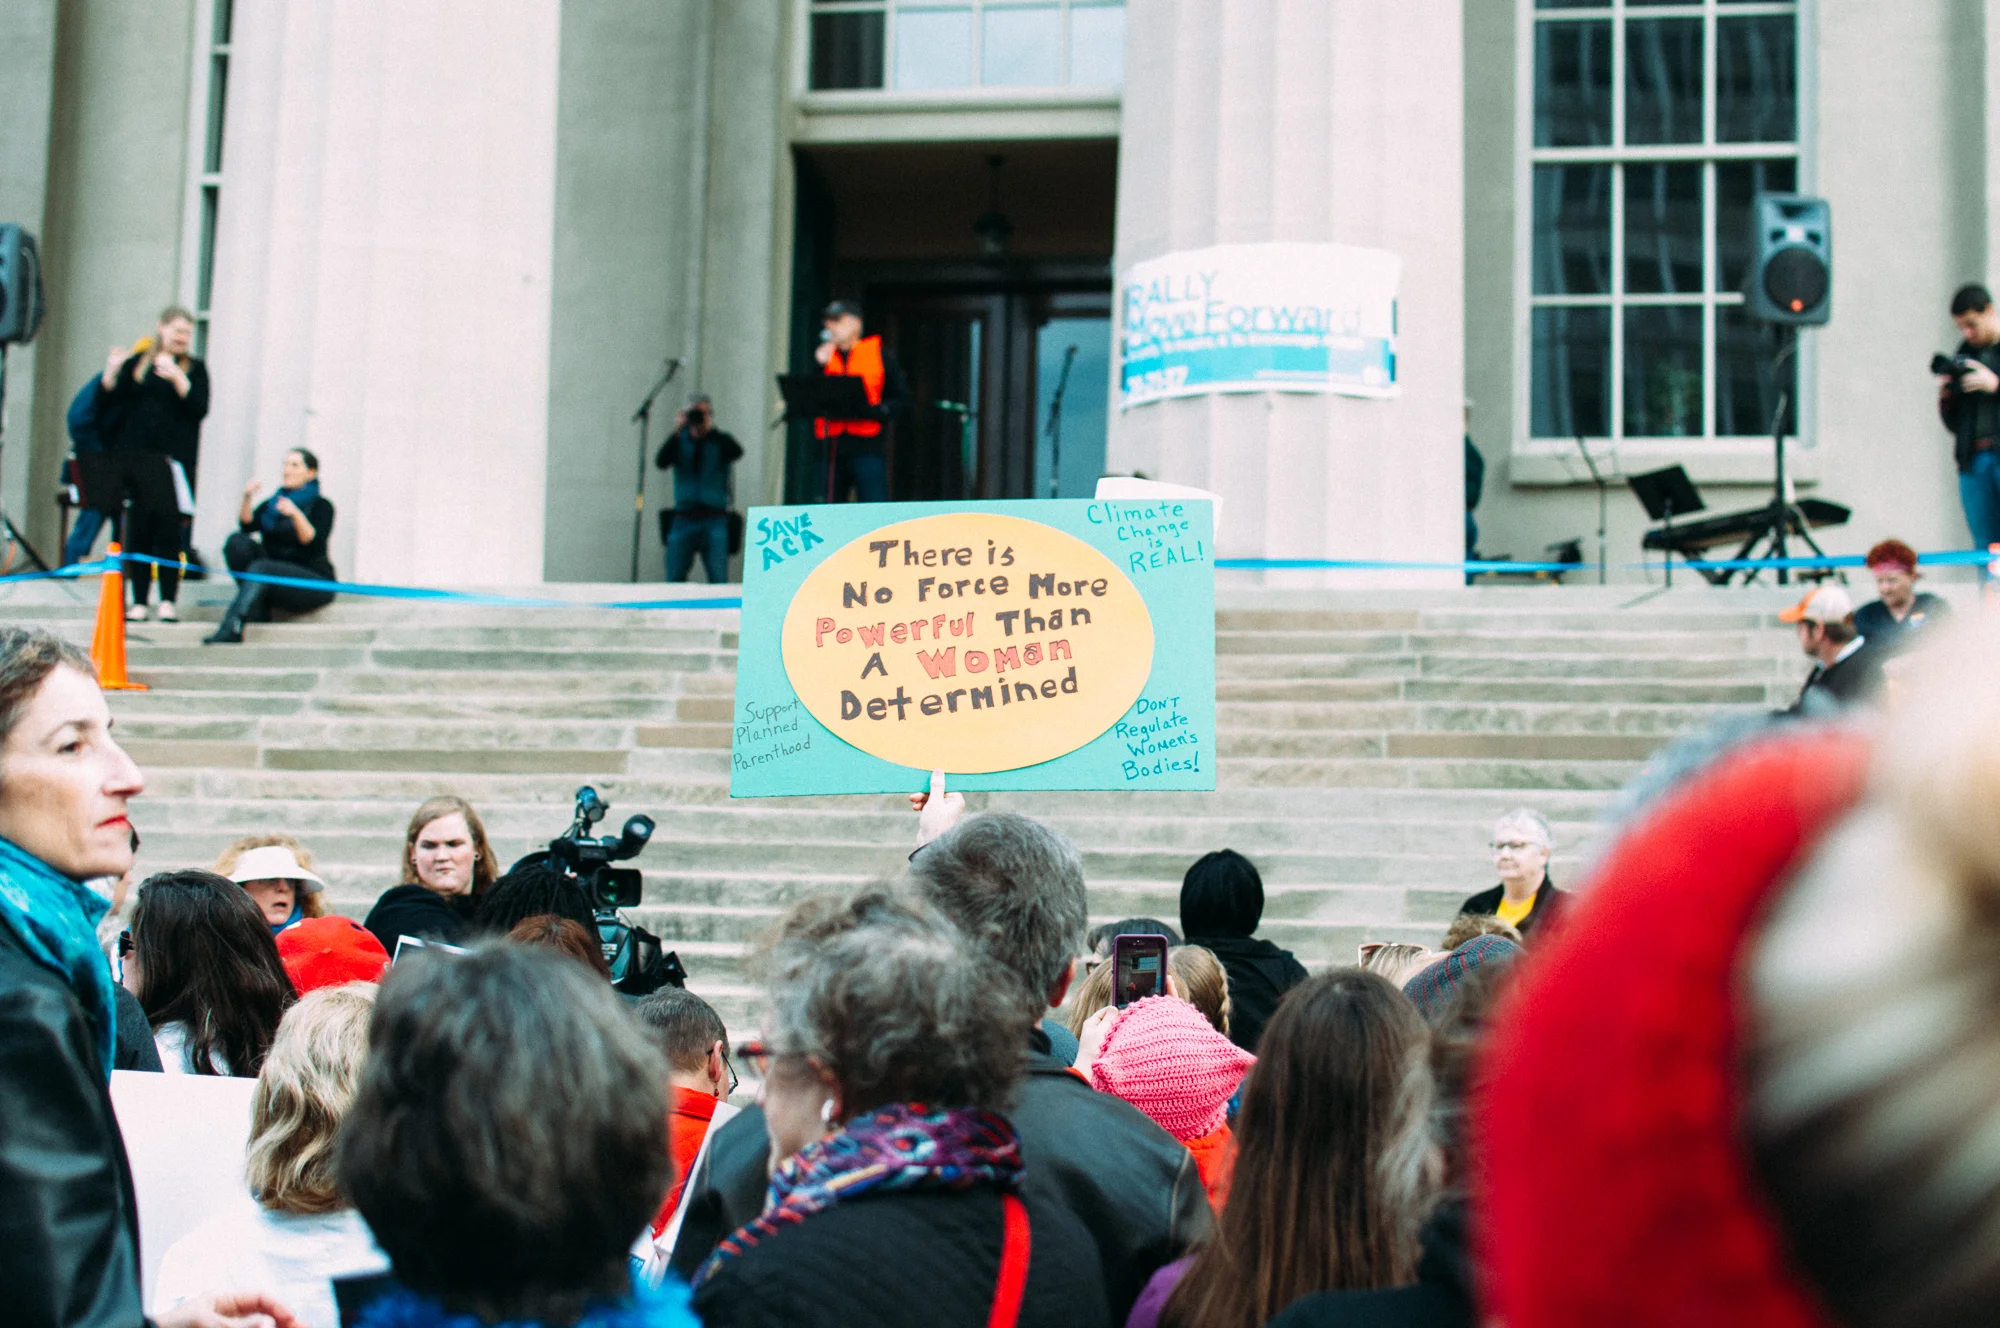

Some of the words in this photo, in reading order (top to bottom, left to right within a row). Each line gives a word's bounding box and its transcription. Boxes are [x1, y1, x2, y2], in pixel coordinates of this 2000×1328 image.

[1128, 268, 1219, 306] RALLY
[1205, 300, 1361, 336] Forward
[1087, 502, 1185, 524] Climate
[755, 512, 813, 546] SAVE
[1117, 519, 1189, 543] Change
[1148, 537, 1163, 548] is
[761, 528, 824, 572] ACA
[869, 540, 973, 569] There
[986, 539, 1016, 566] is
[1130, 540, 1204, 573] REAL!
[842, 581, 893, 608] No
[918, 575, 1009, 602] Force
[1028, 572, 1108, 600] More
[995, 604, 1092, 637] Than
[860, 652, 887, 680] A
[742, 697, 799, 725] Support
[736, 718, 799, 745] Planned
[1115, 713, 1189, 741] Regulate
[732, 735, 812, 772] Parenthood
[1122, 751, 1200, 781] Bodies!
